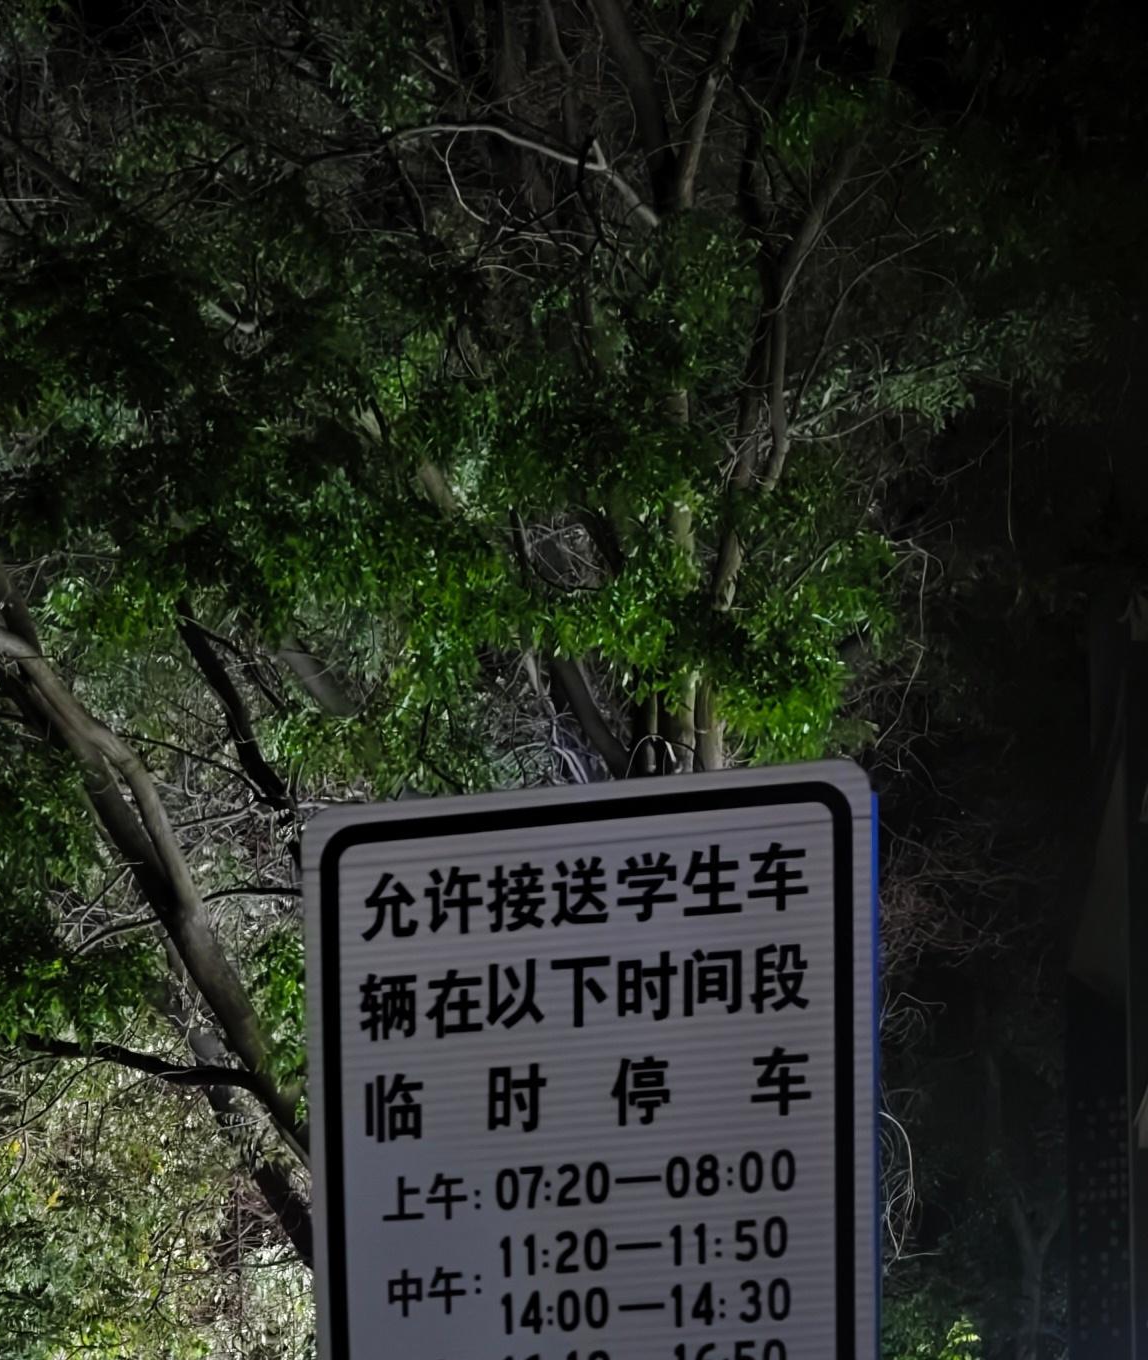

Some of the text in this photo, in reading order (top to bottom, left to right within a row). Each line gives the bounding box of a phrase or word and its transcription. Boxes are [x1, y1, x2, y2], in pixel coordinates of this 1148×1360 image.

[361, 842, 809, 942] 允许接送学生车
[358, 943, 810, 1042] 辆在以下时间段
